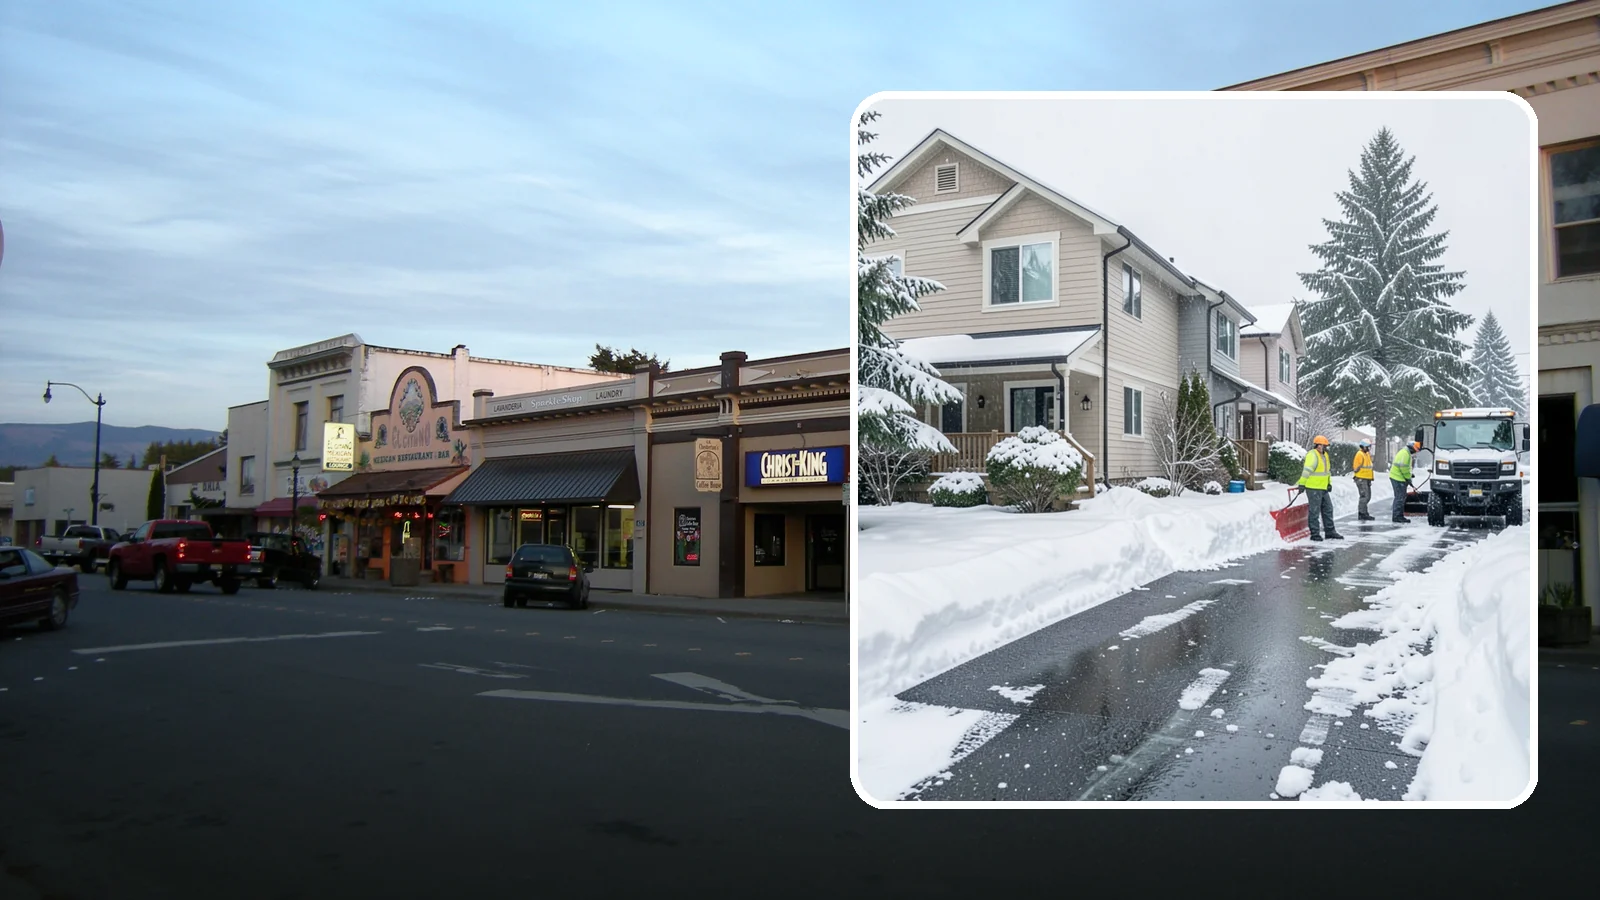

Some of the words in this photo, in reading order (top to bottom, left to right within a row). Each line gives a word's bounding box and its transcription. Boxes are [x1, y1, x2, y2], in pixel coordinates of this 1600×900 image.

[531, 397, 561, 409] Sparkle
[562, 394, 582, 405] Shop
[596, 389, 623, 400] LAUNDRY
[494, 402, 522, 412] LAVANDERIA
[373, 455, 396, 464] MEXICAN
[397, 451, 433, 462] RESTAURANT
[438, 450, 450, 459] BAR
[760, 452, 797, 478] CHRIST
[799, 450, 827, 476] KING
